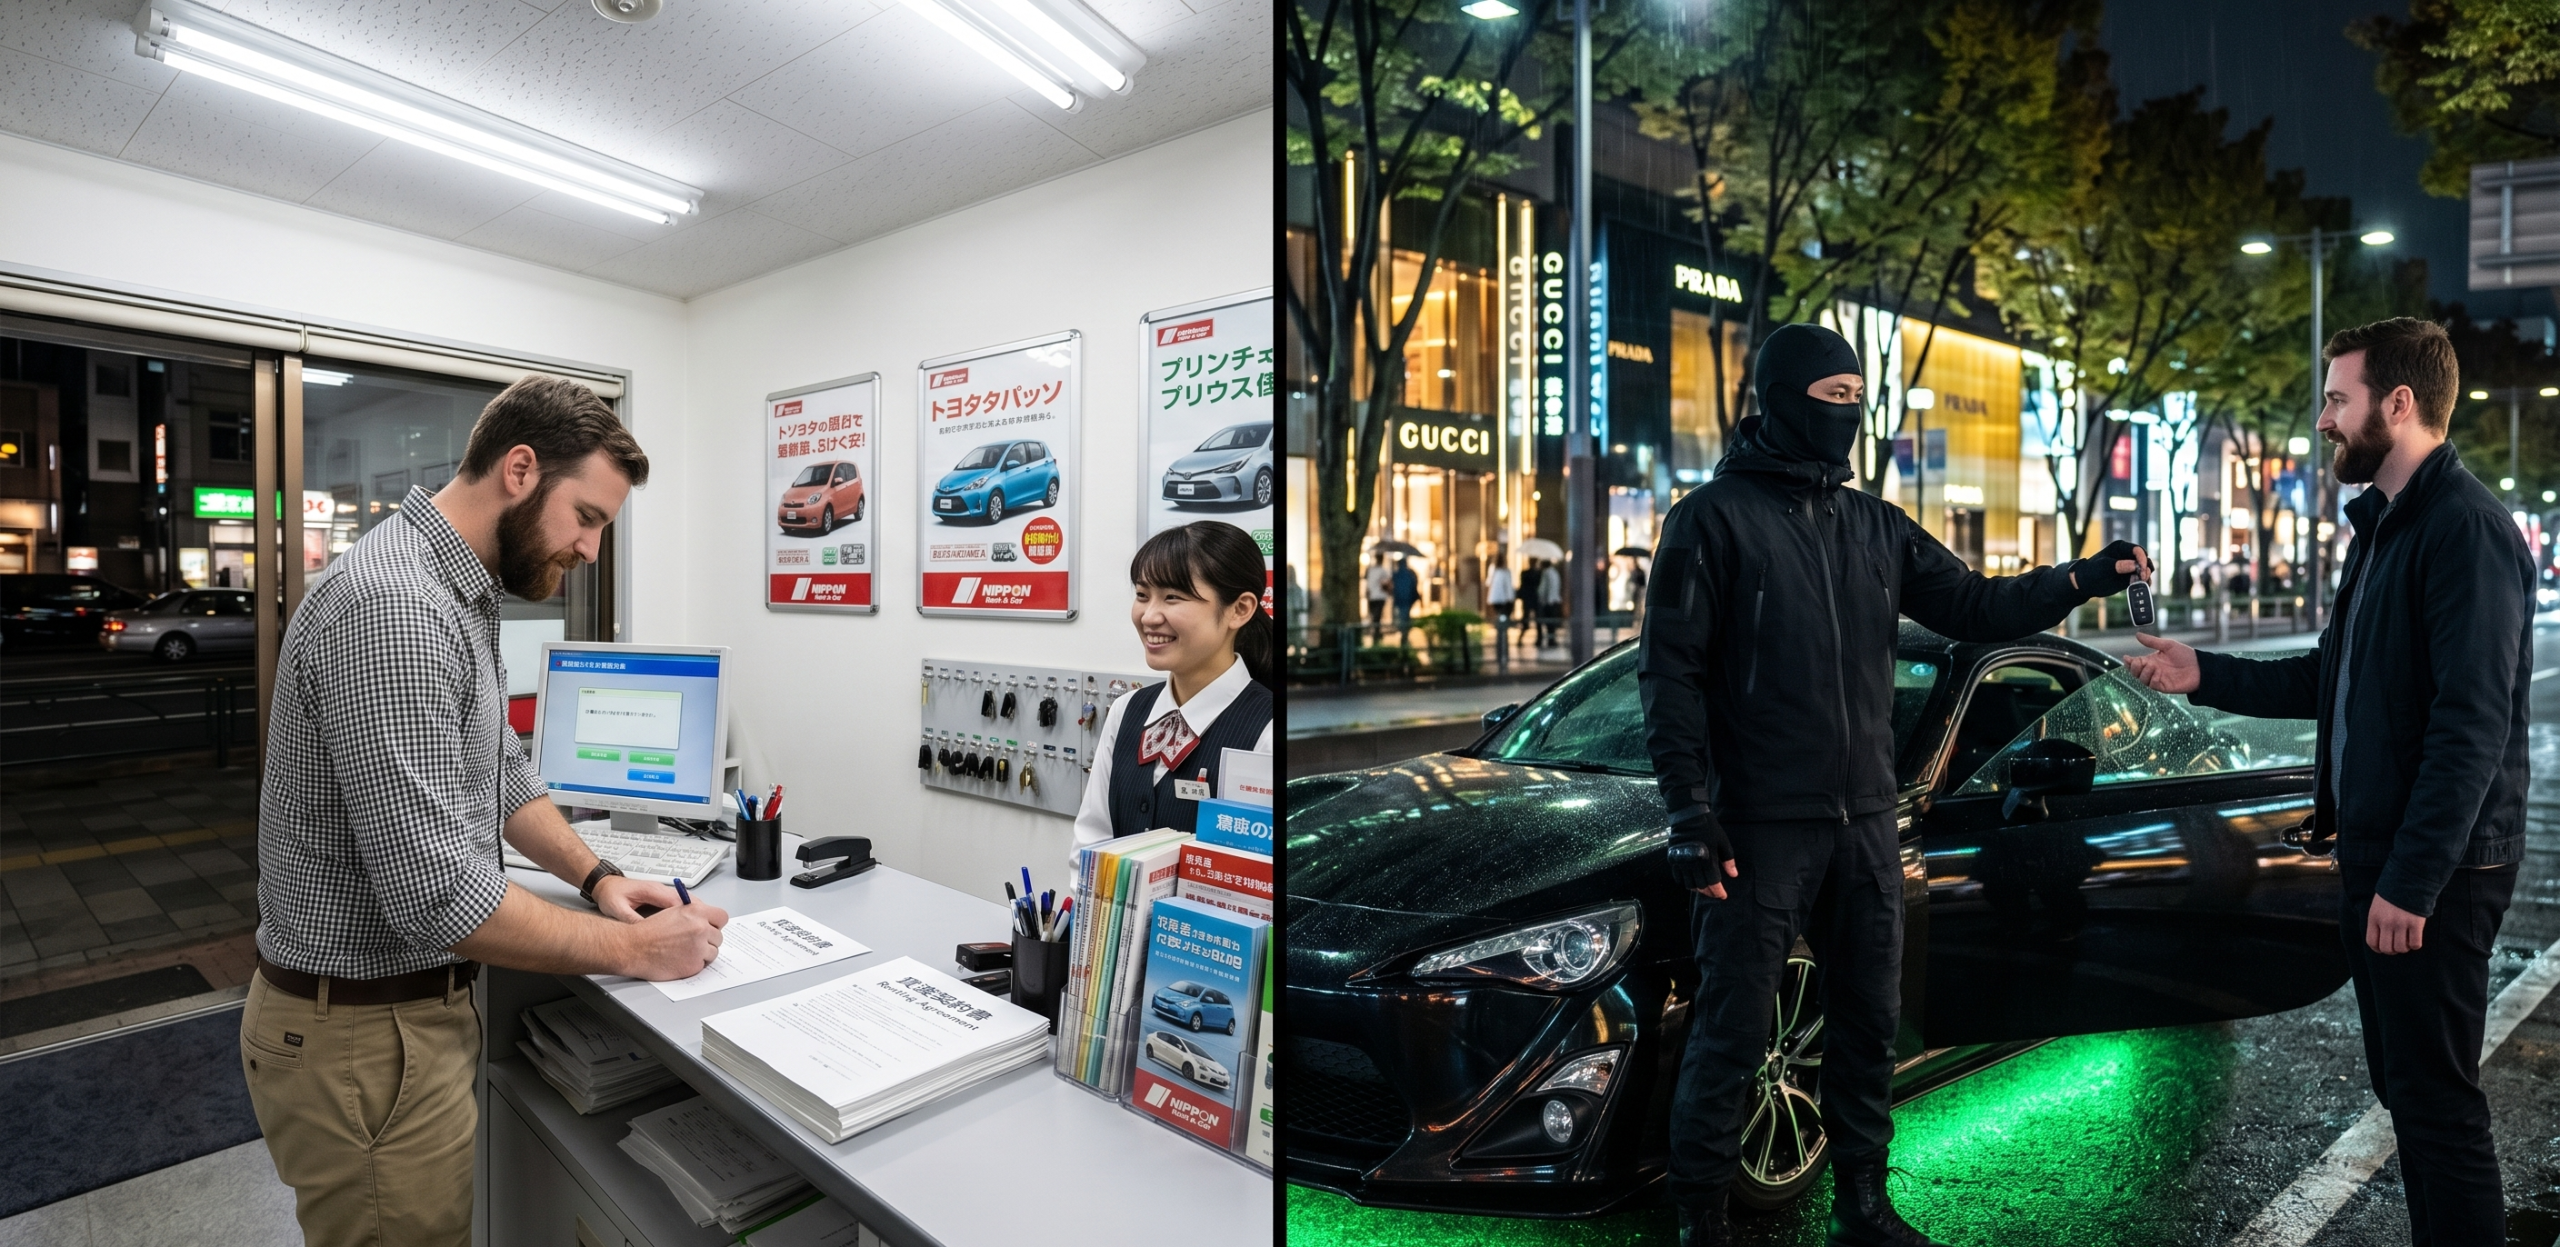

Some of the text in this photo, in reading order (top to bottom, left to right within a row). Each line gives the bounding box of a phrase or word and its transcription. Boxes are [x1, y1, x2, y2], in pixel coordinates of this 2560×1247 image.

[1675, 264, 1742, 303] PRADA
[1543, 252, 1564, 364] GUCCI
[1608, 340, 1654, 364] PRADA
[1400, 422, 1489, 455] GUCCI
[982, 584, 1032, 597] NIPPON
[1170, 1097, 1219, 1126] NIPPON
